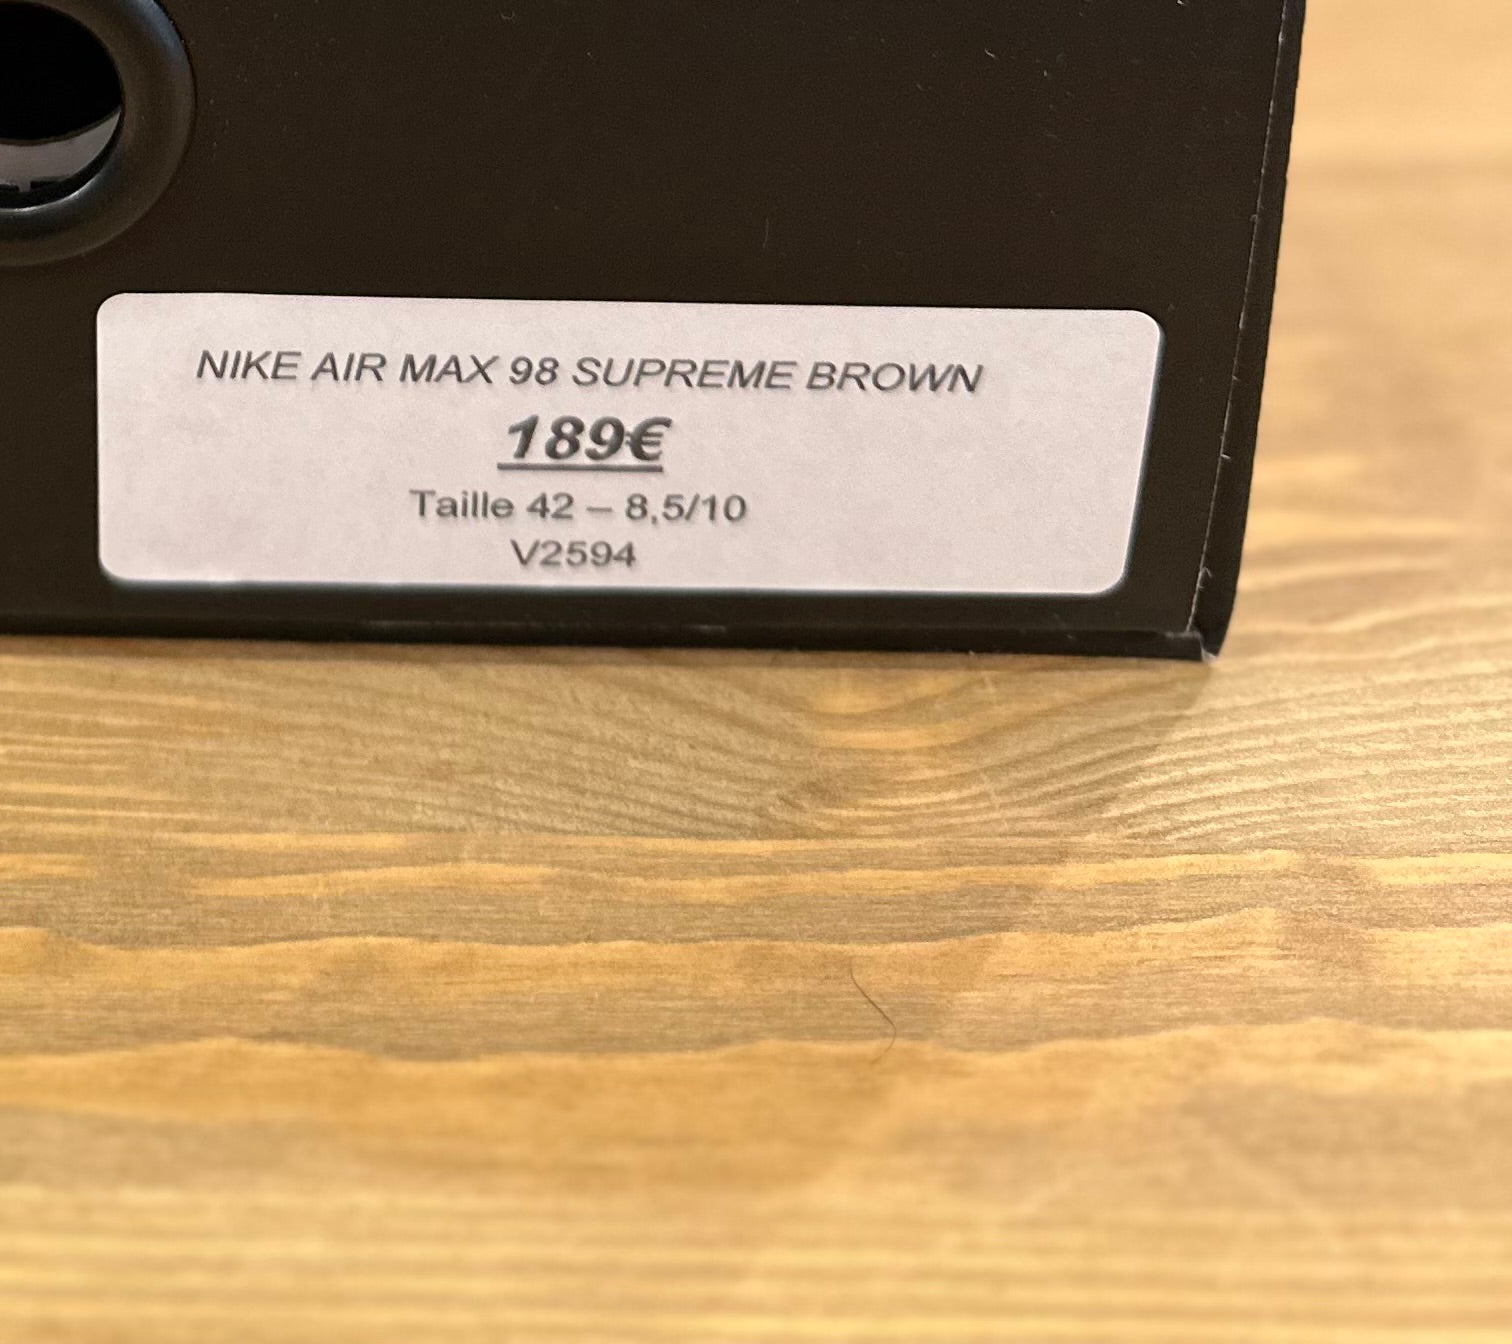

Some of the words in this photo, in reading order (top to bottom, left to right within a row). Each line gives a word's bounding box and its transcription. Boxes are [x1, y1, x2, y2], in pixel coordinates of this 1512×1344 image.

[195, 349, 302, 382] NIKE
[310, 351, 387, 383] AIR
[398, 353, 499, 384] MAX
[508, 356, 560, 386] 98
[571, 357, 798, 390] SUPREME
[805, 361, 984, 393] BROWN
[506, 414, 673, 462] 189€
[408, 489, 515, 519] Taille
[525, 492, 575, 520] 42
[624, 493, 748, 525] 8,5/10
[510, 539, 636, 568] V2594
